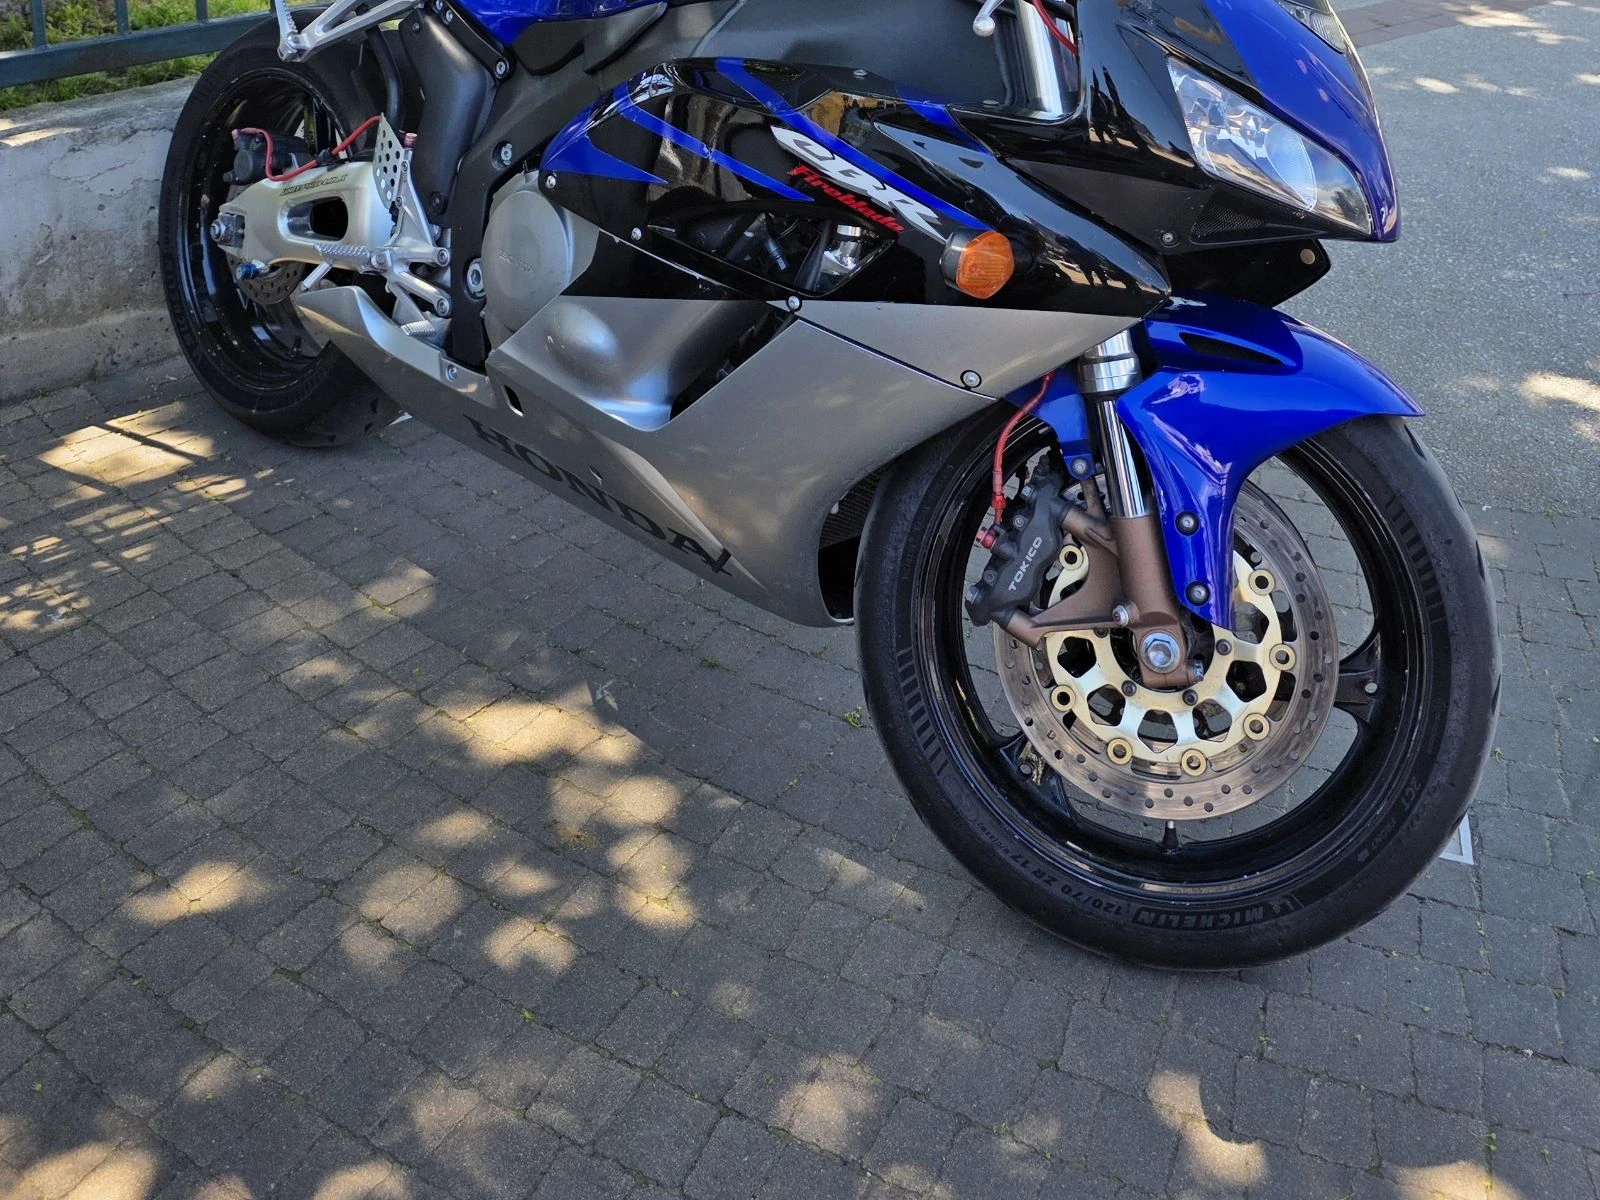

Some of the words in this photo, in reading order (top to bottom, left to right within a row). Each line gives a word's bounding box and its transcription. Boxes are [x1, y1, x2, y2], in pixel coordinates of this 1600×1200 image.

[787, 163, 905, 232] Fireblade
[462, 413, 733, 577] HONDA
[1008, 536, 1043, 591] TOKICO
[1010, 854, 1031, 868] 17
[1032, 867, 1059, 887] ZR
[1060, 884, 1123, 915] 120/70
[1137, 906, 1264, 928] MICHELIN
